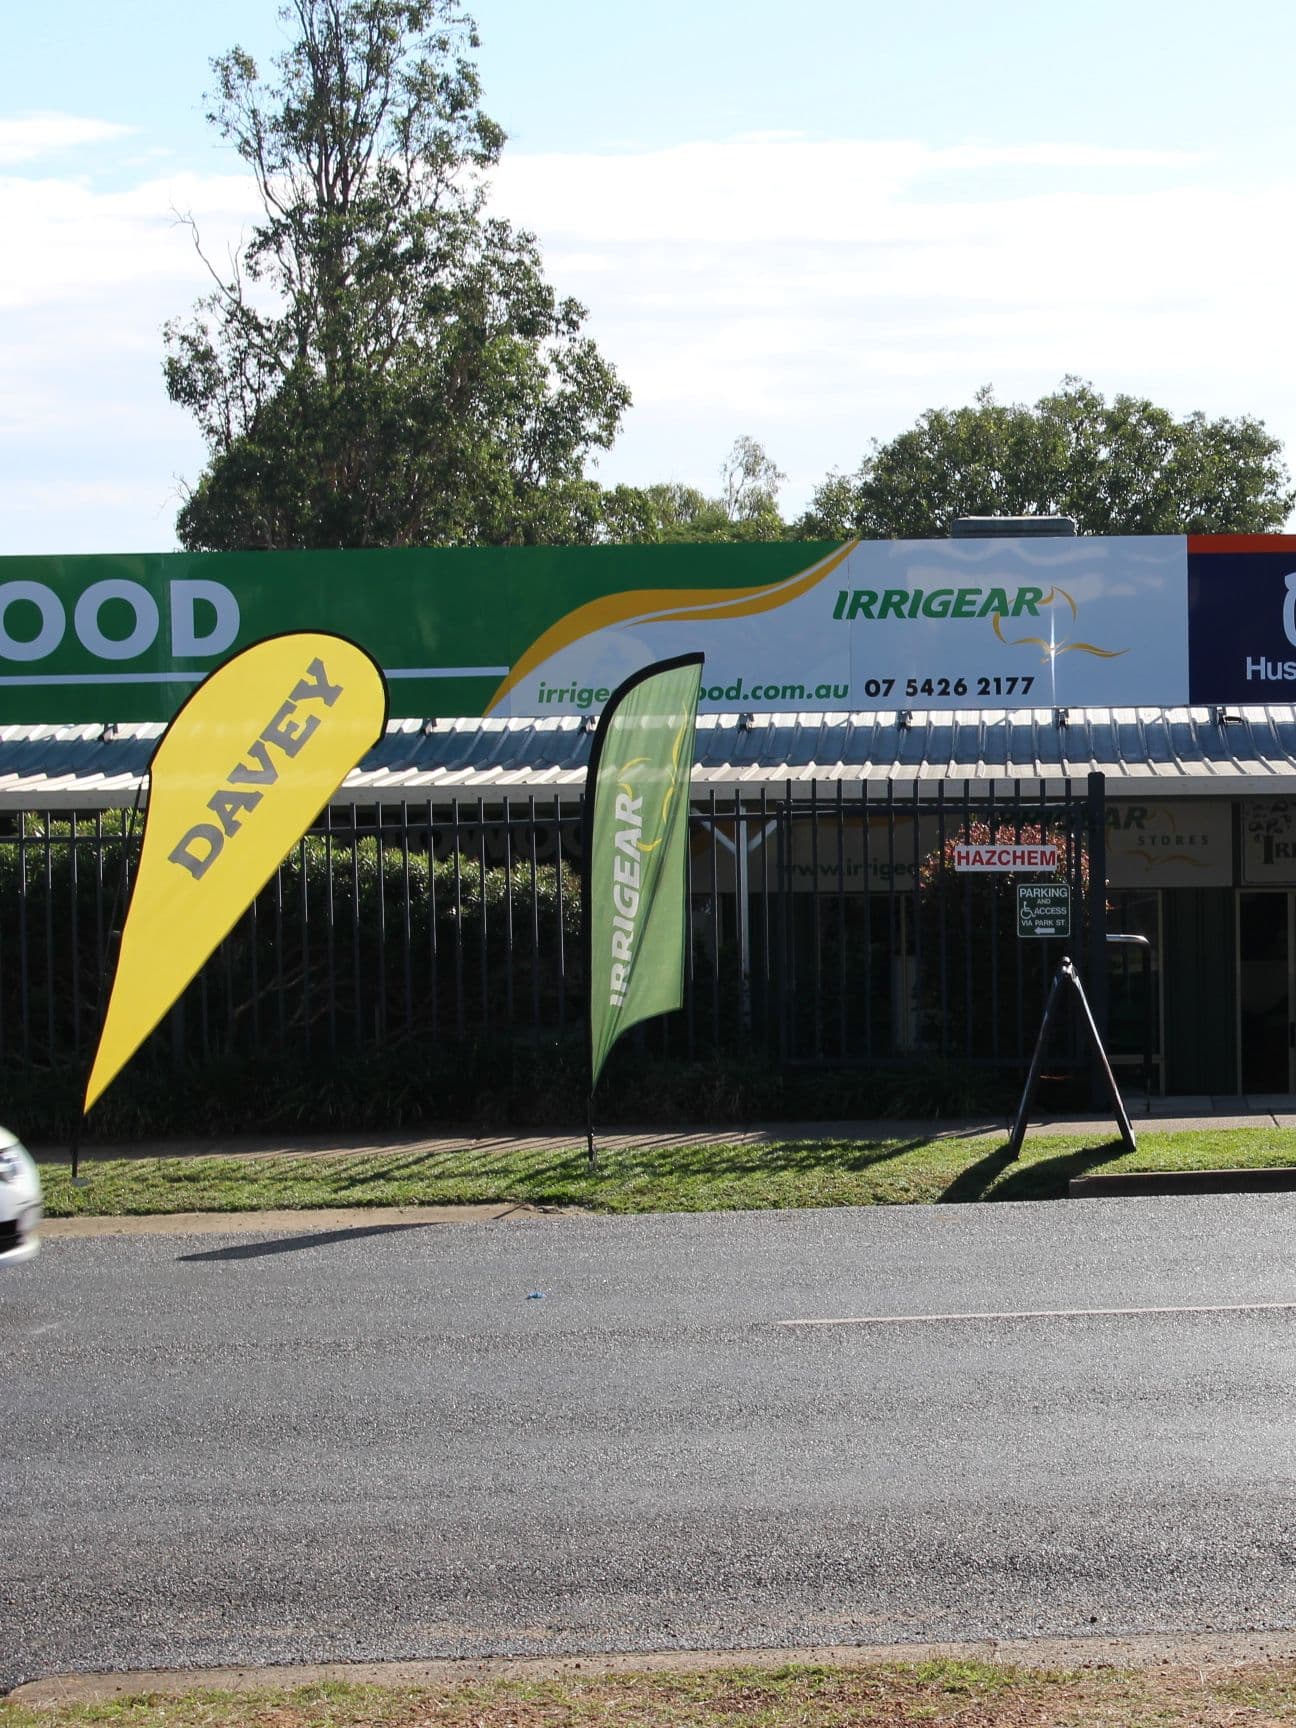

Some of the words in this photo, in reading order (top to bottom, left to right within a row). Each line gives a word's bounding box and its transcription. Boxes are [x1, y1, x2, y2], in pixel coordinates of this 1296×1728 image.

[832, 586, 1043, 620] IRRIGEAR
[864, 678, 896, 697] 07
[905, 677, 968, 697] 5426
[977, 676, 1035, 696] 2177
[168, 657, 344, 881] DAVEY
[1136, 834, 1209, 846] STORES
[956, 850, 1056, 866] HAZCHEM
[609, 791, 644, 1008] IRRIGEAR
[1019, 887, 1068, 898] PARKING
[1034, 907, 1067, 915] ACCESS
